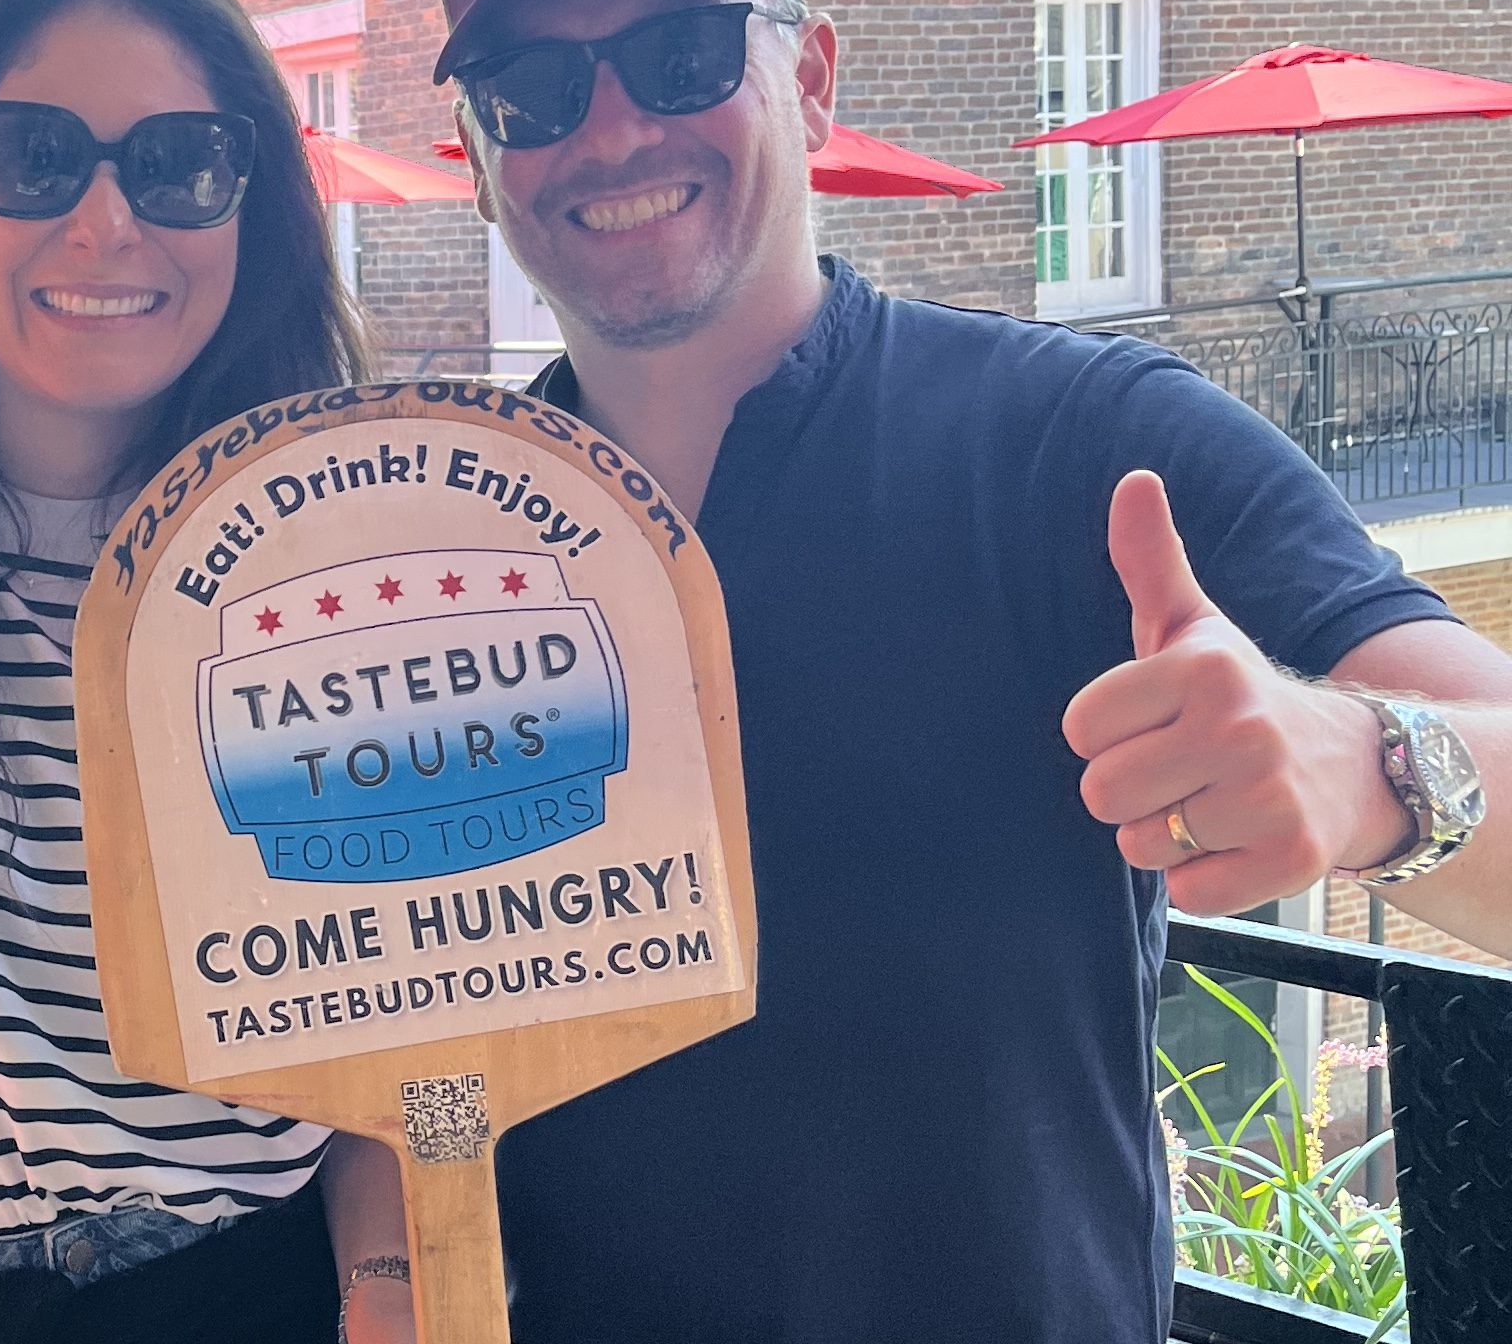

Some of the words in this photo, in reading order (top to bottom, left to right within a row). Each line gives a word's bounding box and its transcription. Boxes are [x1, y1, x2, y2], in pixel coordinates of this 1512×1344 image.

[174, 502, 266, 608] Eat!
[263, 444, 429, 520] Drink!
[445, 448, 602, 559] Enjoy!
[233, 632, 578, 730] TASTEBUD
[274, 829, 411, 872] FOOD
[428, 787, 595, 857] TOURS
[194, 905, 384, 984] COME
[405, 852, 703, 950] HUNGRY!
[206, 930, 713, 1044] TASTEBUDTOURS.COM
